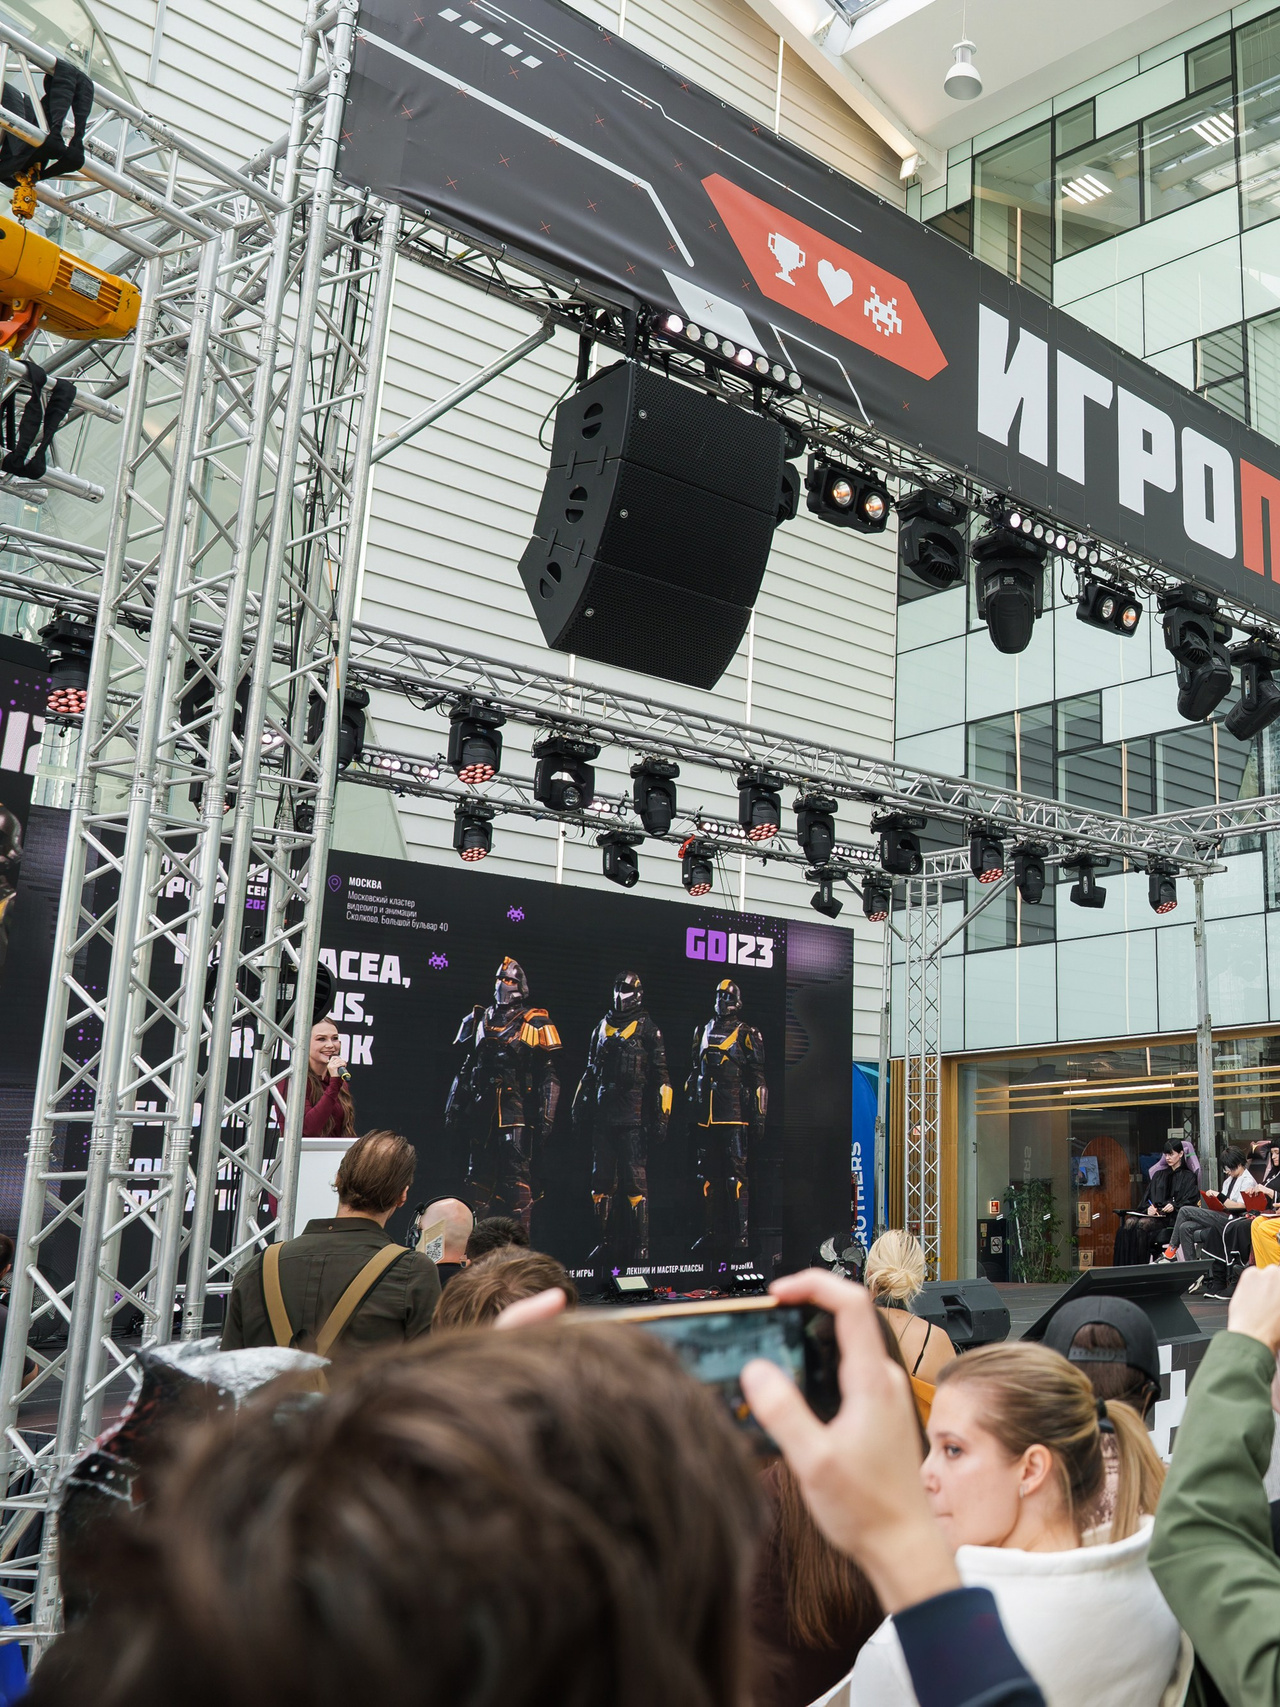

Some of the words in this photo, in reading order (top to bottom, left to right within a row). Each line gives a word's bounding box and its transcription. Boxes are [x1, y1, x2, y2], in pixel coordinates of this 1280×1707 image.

[348, 876, 383, 890] МОСКВА
[347, 890, 388, 904] Московский
[389, 898, 416, 909] кластер
[346, 902, 378, 913] видеоигр
[385, 907, 418, 918] анимации
[381, 914, 411, 927] Большой
[411, 919, 438, 932] бульвар
[439, 922, 449, 932] 40
[685, 926, 775, 969] GD123
[576, 1268, 594, 1278] ИГРЫ
[625, 1266, 650, 1276] ЛЕКЦИИ
[657, 1263, 704, 1275] МАСТЕР-КЛАССЫ
